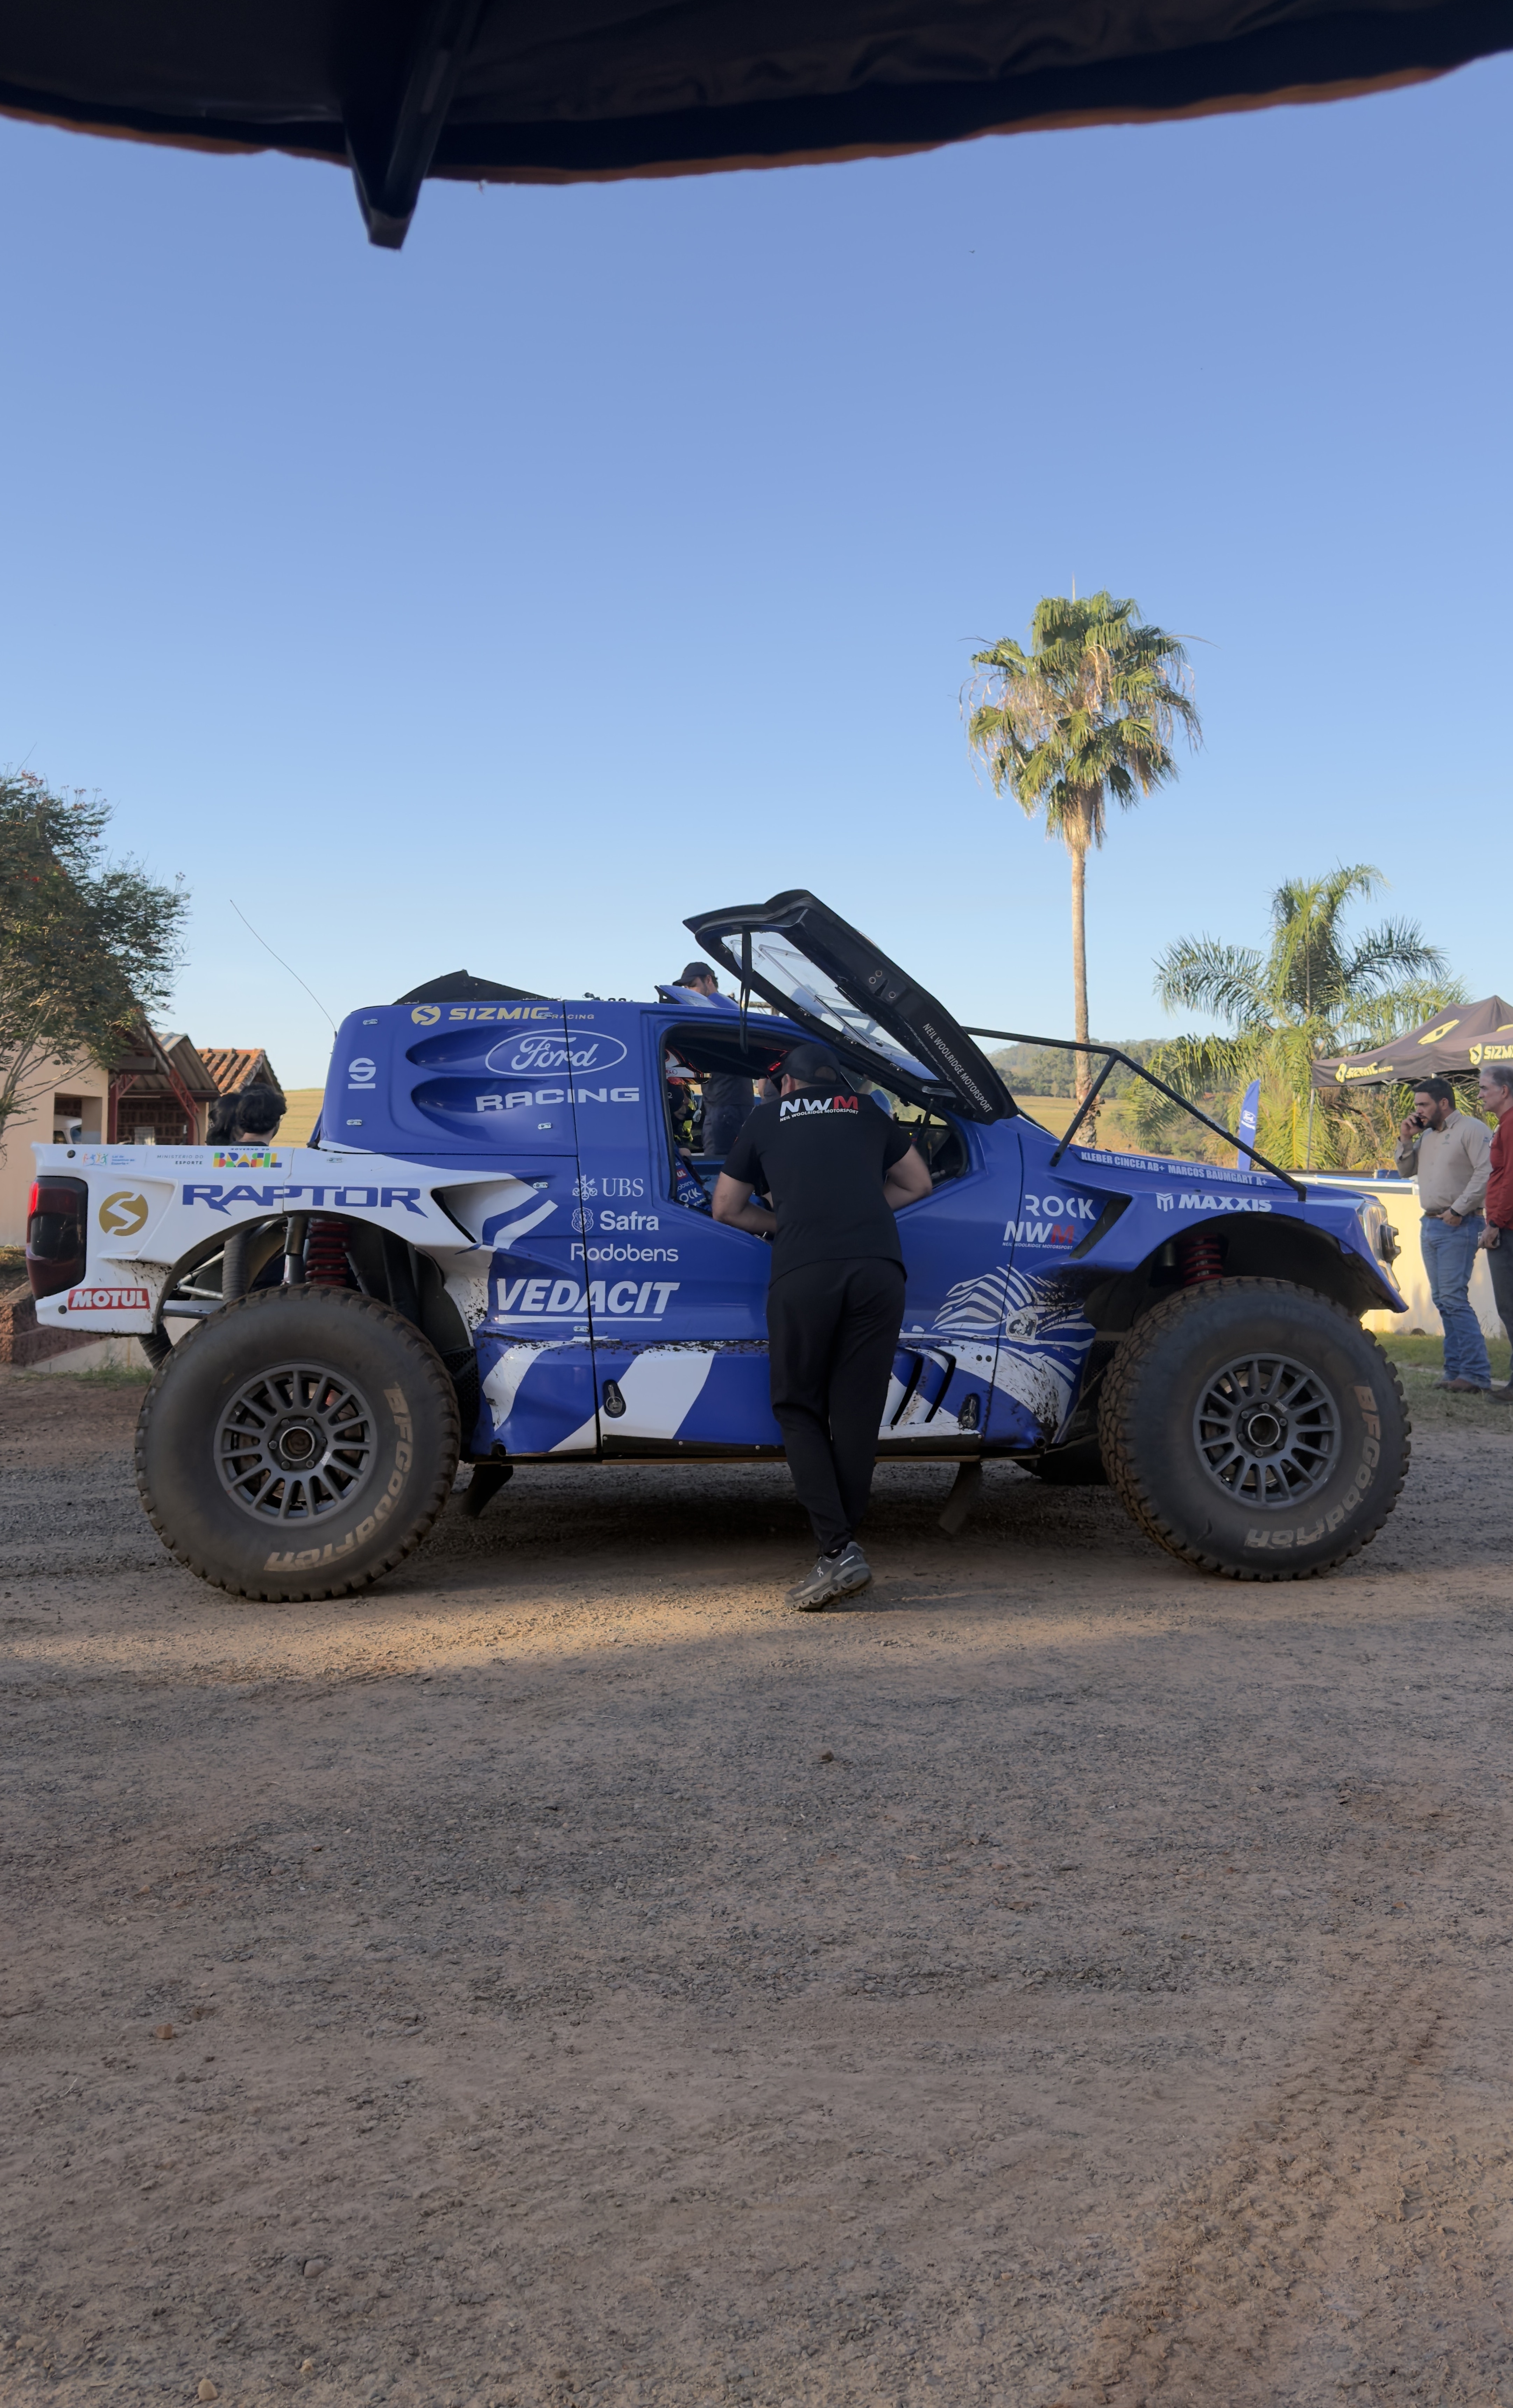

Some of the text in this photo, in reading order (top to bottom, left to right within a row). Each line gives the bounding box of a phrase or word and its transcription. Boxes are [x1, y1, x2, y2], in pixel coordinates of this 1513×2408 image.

[448, 1007, 549, 1020] SIZMIC
[511, 1036, 599, 1071] Ford
[923, 1023, 993, 1113] NEIL WOOLRIDGE MOTORSPORT
[476, 1087, 639, 1112] RACING
[780, 1096, 858, 1117] NWM
[791, 1110, 823, 1118] WOOLRIDGE
[213, 1152, 282, 1168] BRASIL
[1081, 1152, 1165, 1172] KLEBER CINCEA AB+
[1168, 1164, 1205, 1178] MARCOS
[1206, 1170, 1253, 1185] BAUMGART
[601, 1178, 644, 1197] UBS
[679, 1187, 702, 1203] OCK
[182, 1184, 429, 1219] RAPTOR
[1025, 1194, 1096, 1220] ROCK
[1178, 1194, 1272, 1212] MAXXIS
[600, 1210, 659, 1231] Safra
[1003, 1221, 1075, 1244] NWM
[571, 1243, 679, 1262] Rodobens
[71, 1290, 147, 1308] MOTUL
[496, 1278, 680, 1314] VEDACIT
